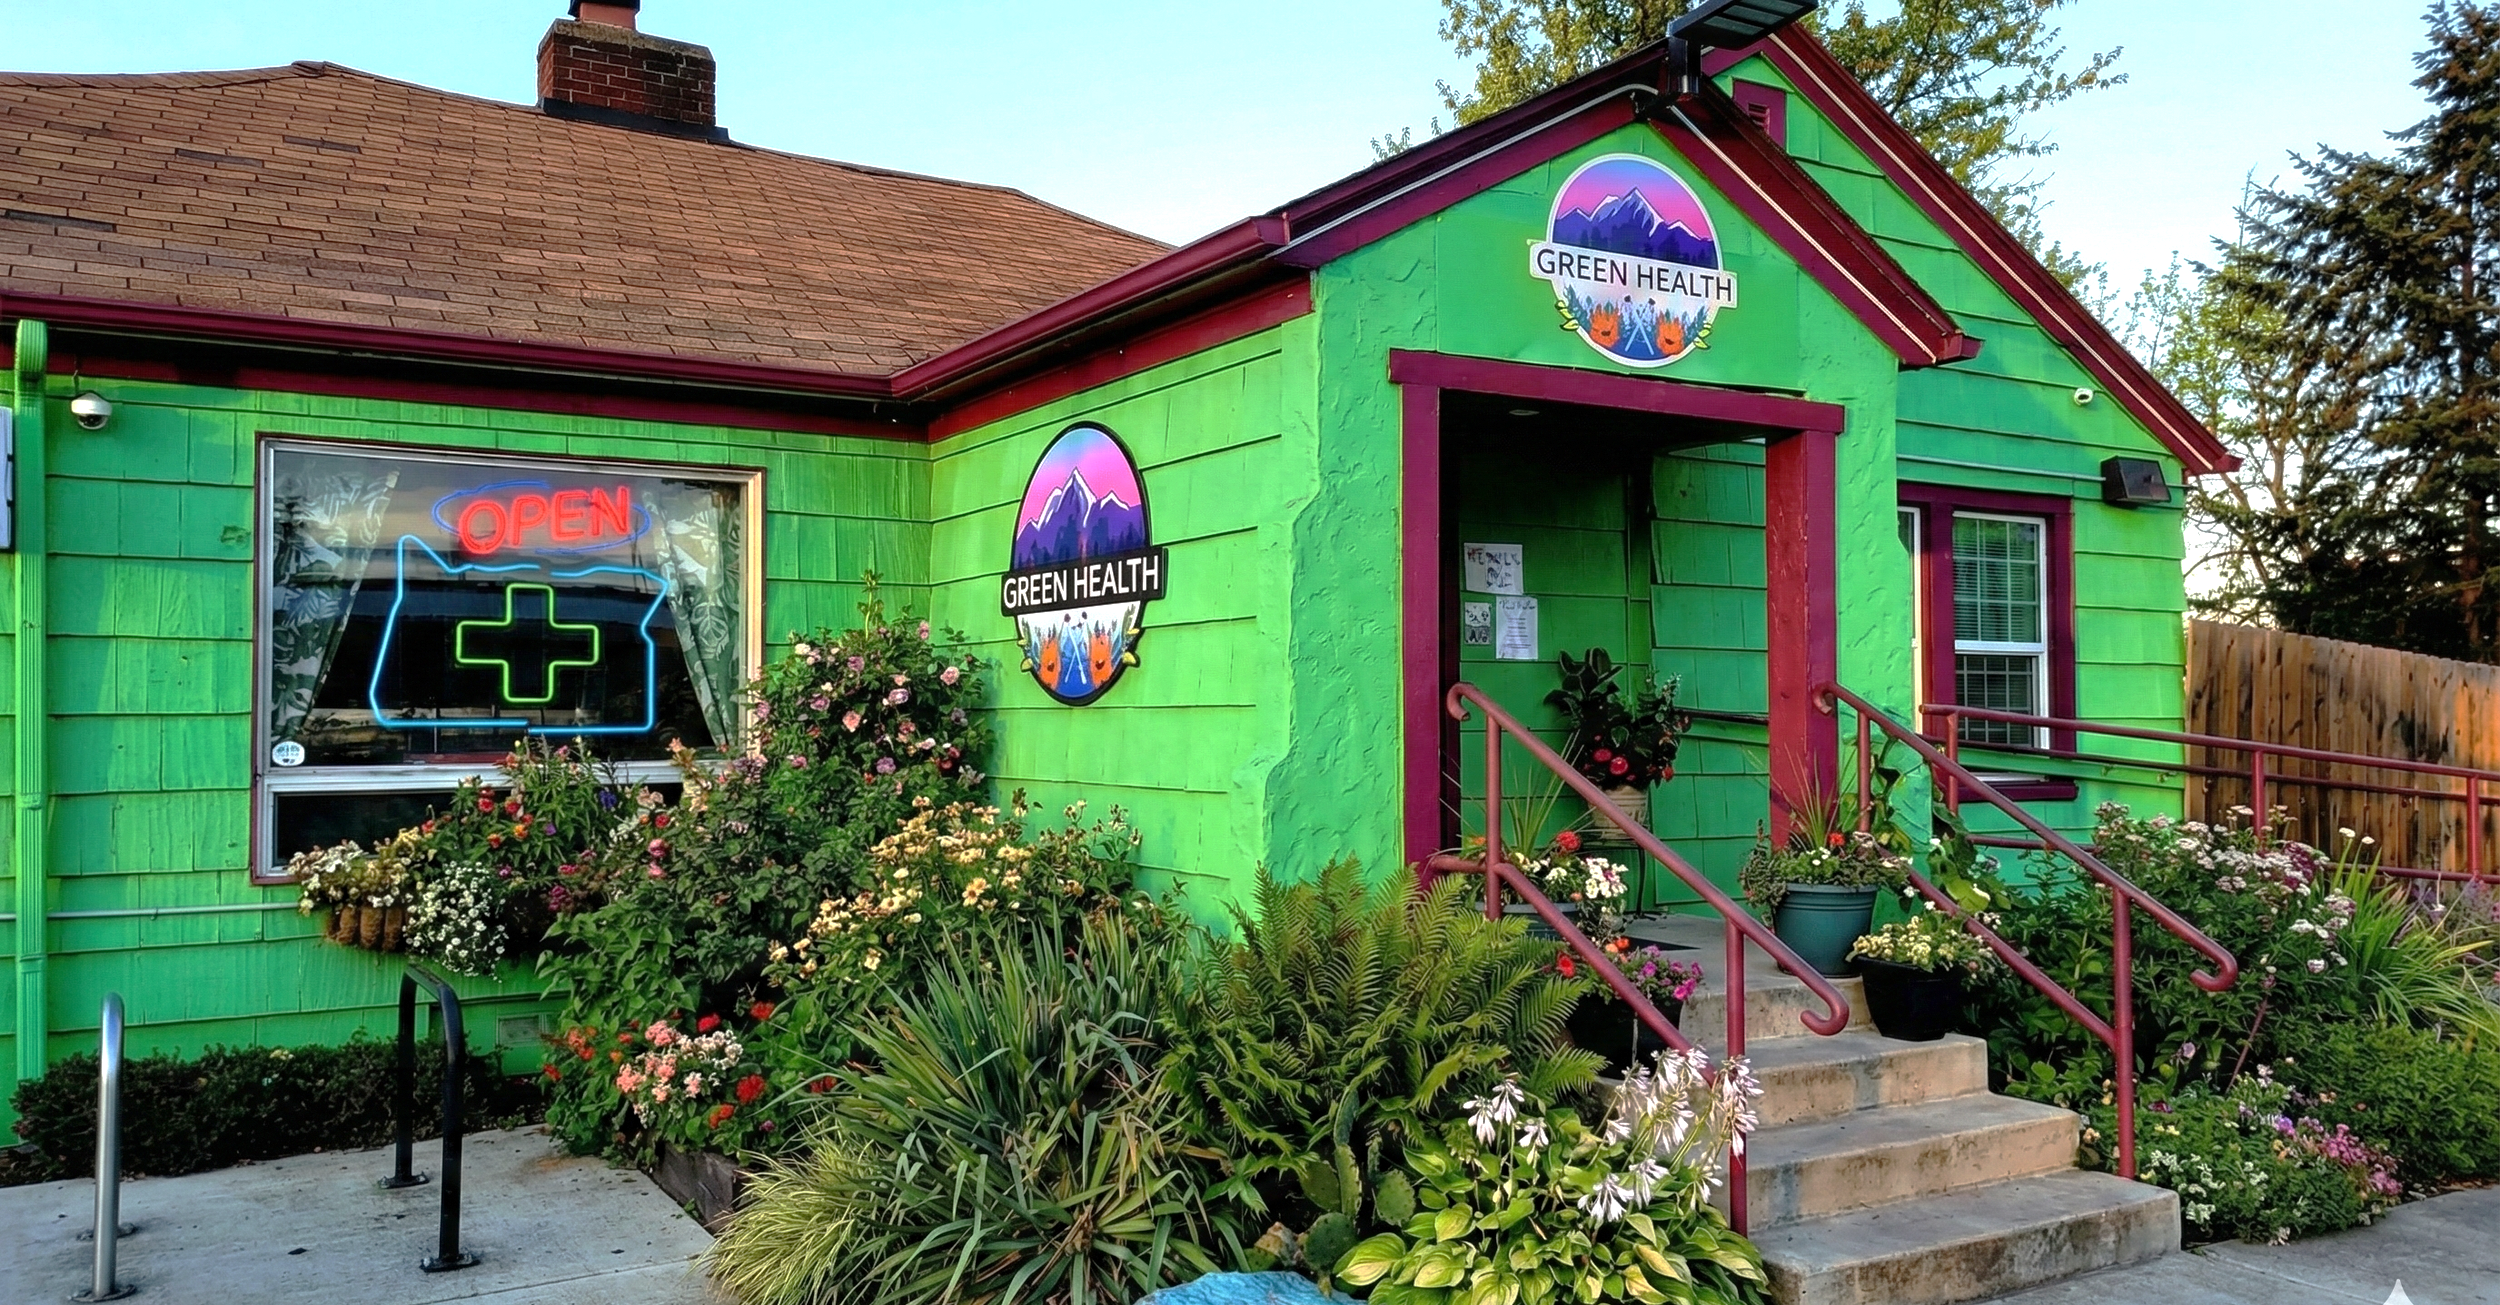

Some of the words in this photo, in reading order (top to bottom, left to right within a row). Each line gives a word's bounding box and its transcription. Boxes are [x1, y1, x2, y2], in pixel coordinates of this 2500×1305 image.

[1536, 248, 1628, 287] GREEN
[1636, 263, 1732, 302] HEALTH
[458, 485, 630, 555] OPEN
[1003, 569, 1068, 609] GREEN
[1073, 554, 1159, 600] HEALTH
